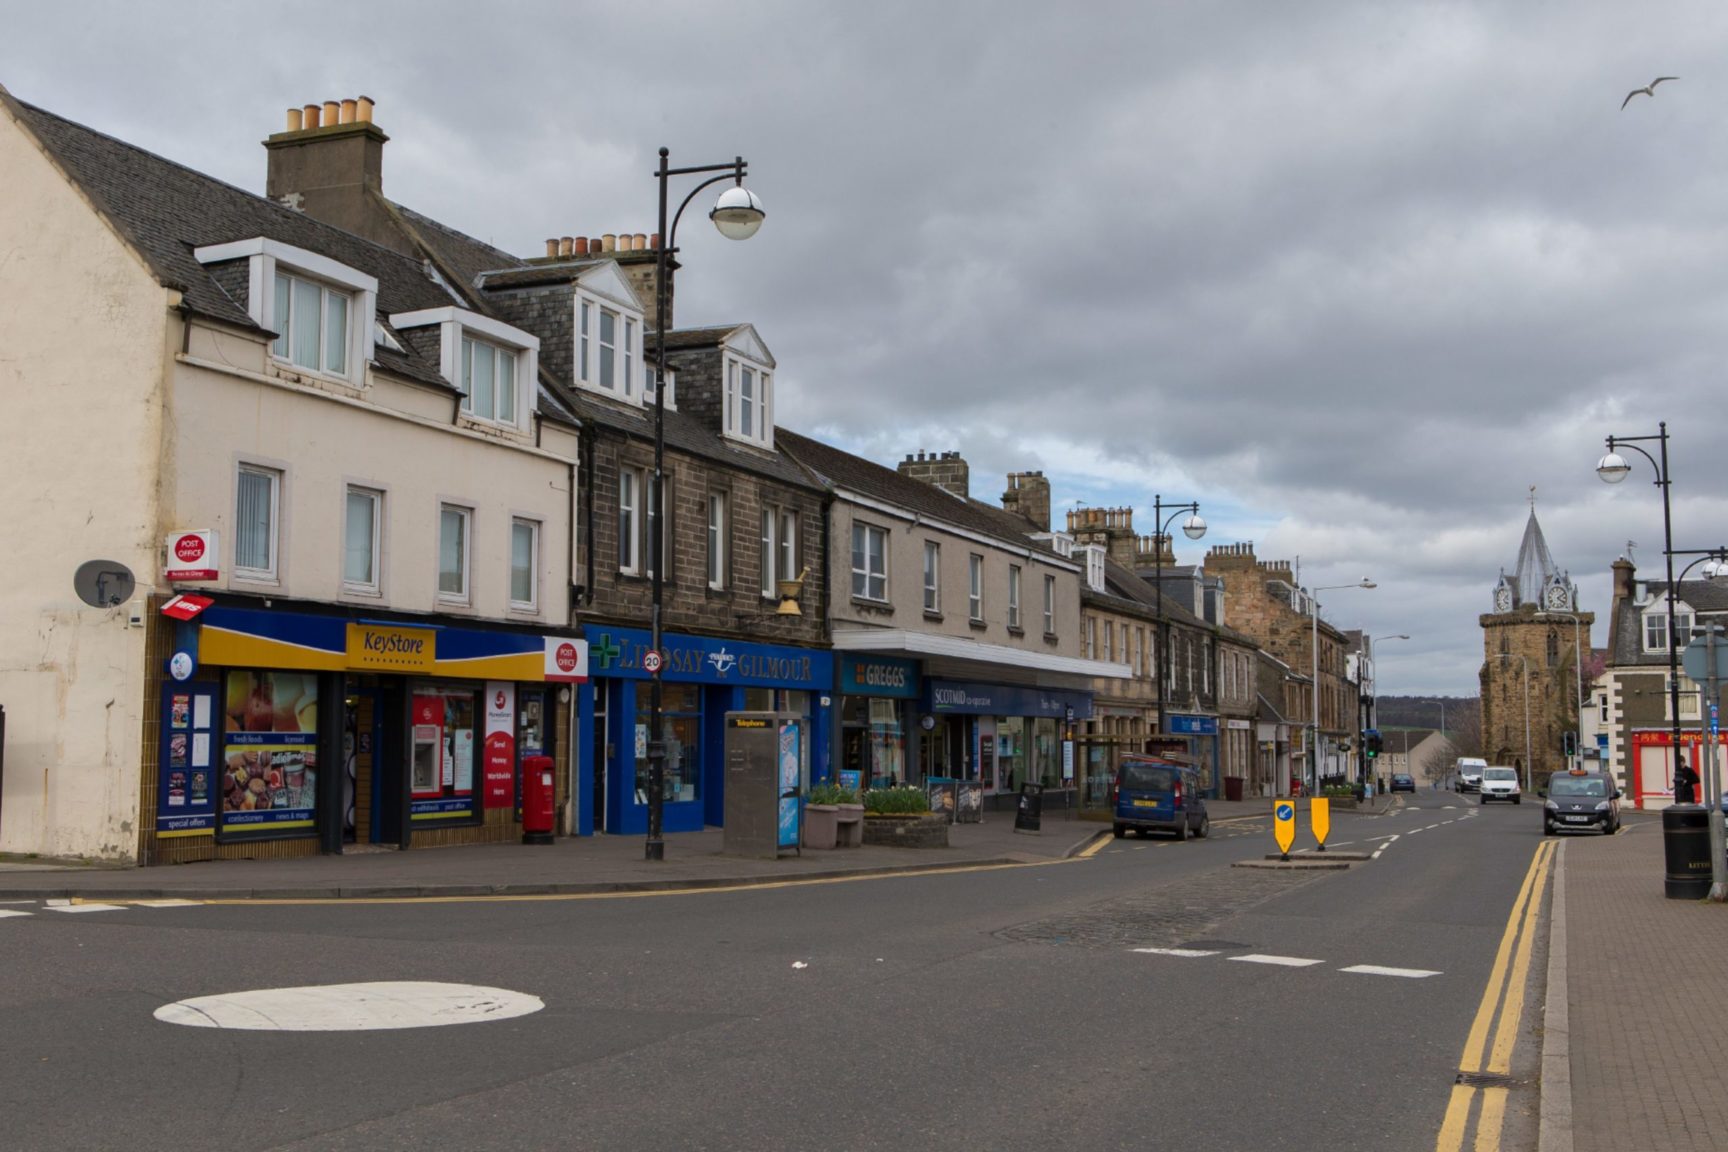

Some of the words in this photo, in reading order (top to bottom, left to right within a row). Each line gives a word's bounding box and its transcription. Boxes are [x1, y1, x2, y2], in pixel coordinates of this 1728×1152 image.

[178, 549, 202, 558] OFFICE
[364, 631, 424, 654] KeyStore
[560, 648, 573, 656] POST
[558, 658, 575, 667] OFFICE
[646, 657, 659, 667] 20
[738, 654, 812, 681] GILMOUR
[866, 664, 905, 688] GREGGS
[935, 687, 967, 705] SCOTMID
[736, 719, 765, 727] Telephone
[233, 735, 248, 743] fresh
[248, 735, 263, 743] foods
[491, 757, 507, 765] Money
[168, 819, 189, 830] special
[190, 817, 206, 827] offers
